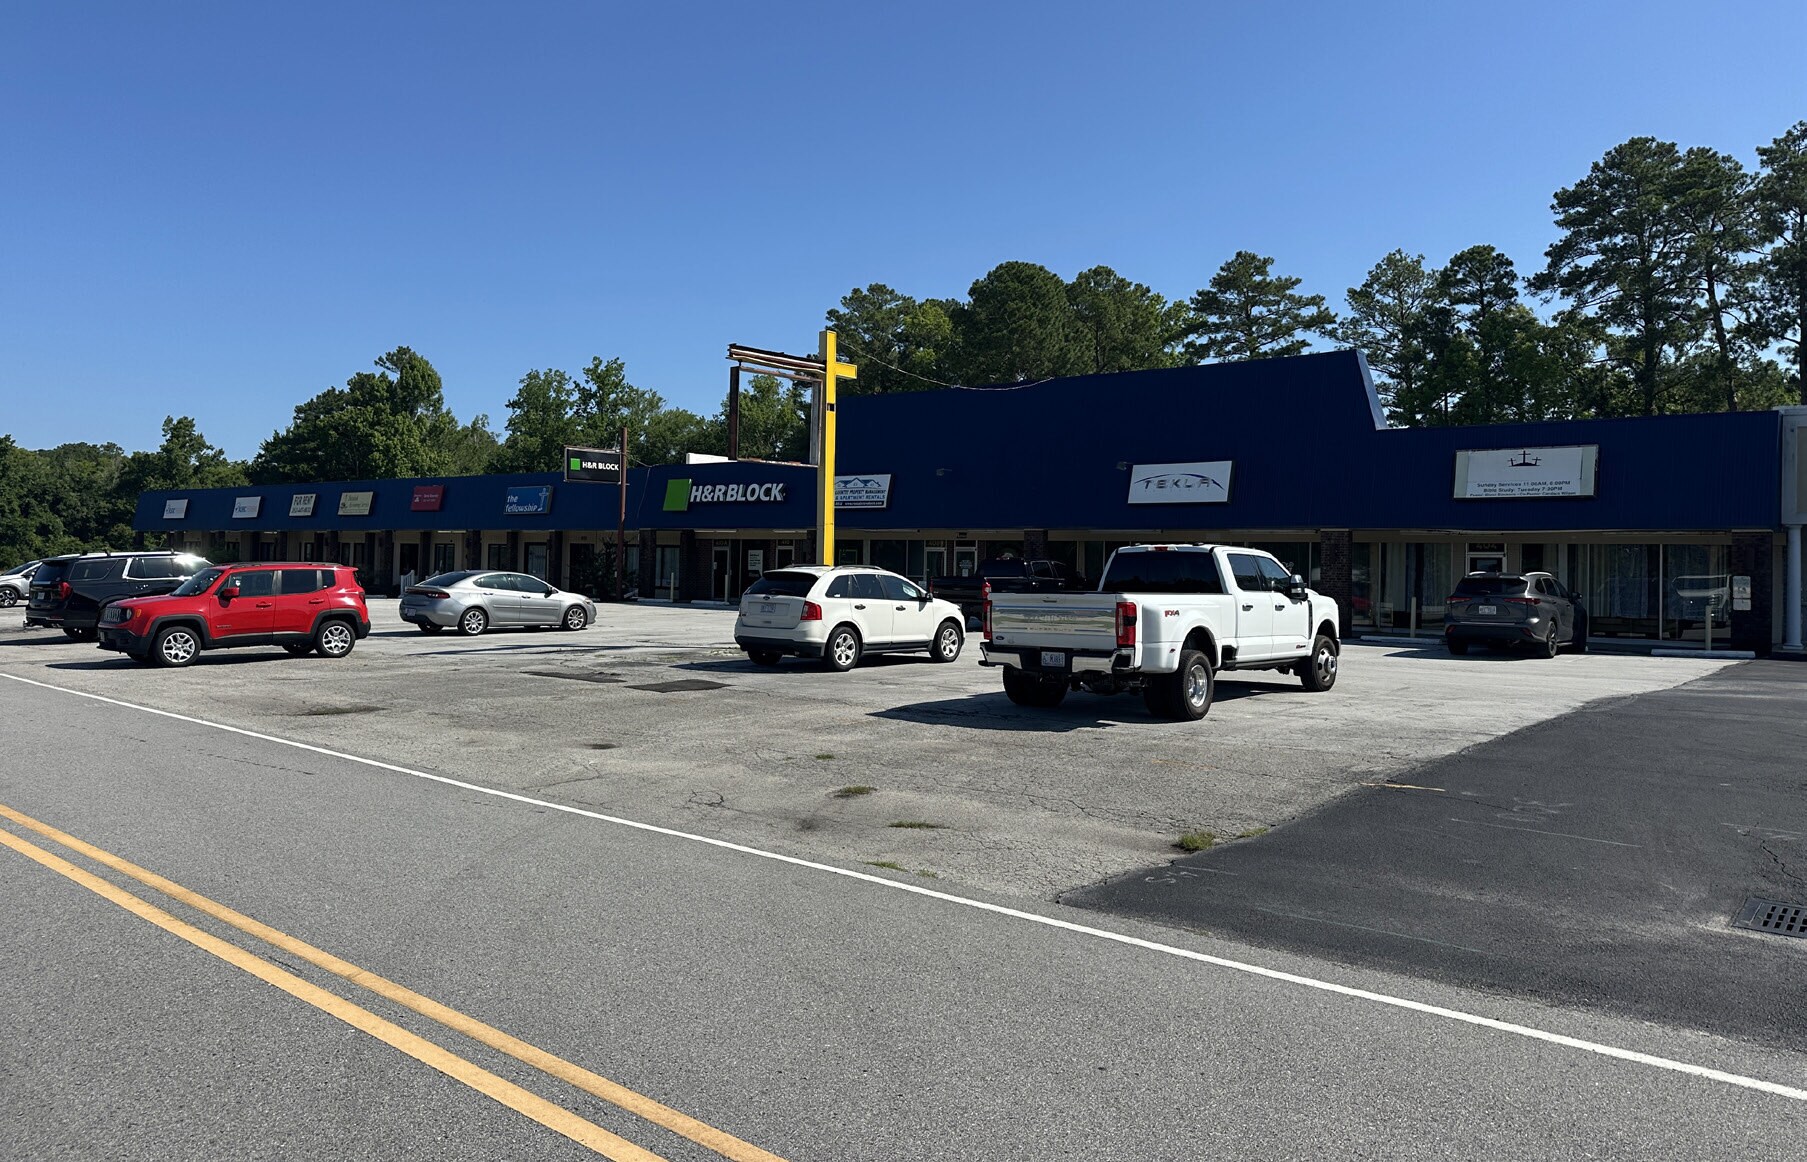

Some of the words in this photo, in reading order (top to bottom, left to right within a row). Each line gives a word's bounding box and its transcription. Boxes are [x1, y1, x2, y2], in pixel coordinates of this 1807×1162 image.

[582, 461, 597, 469] H&R
[598, 462, 619, 471] BLOCK
[505, 503, 538, 512] fellowship
